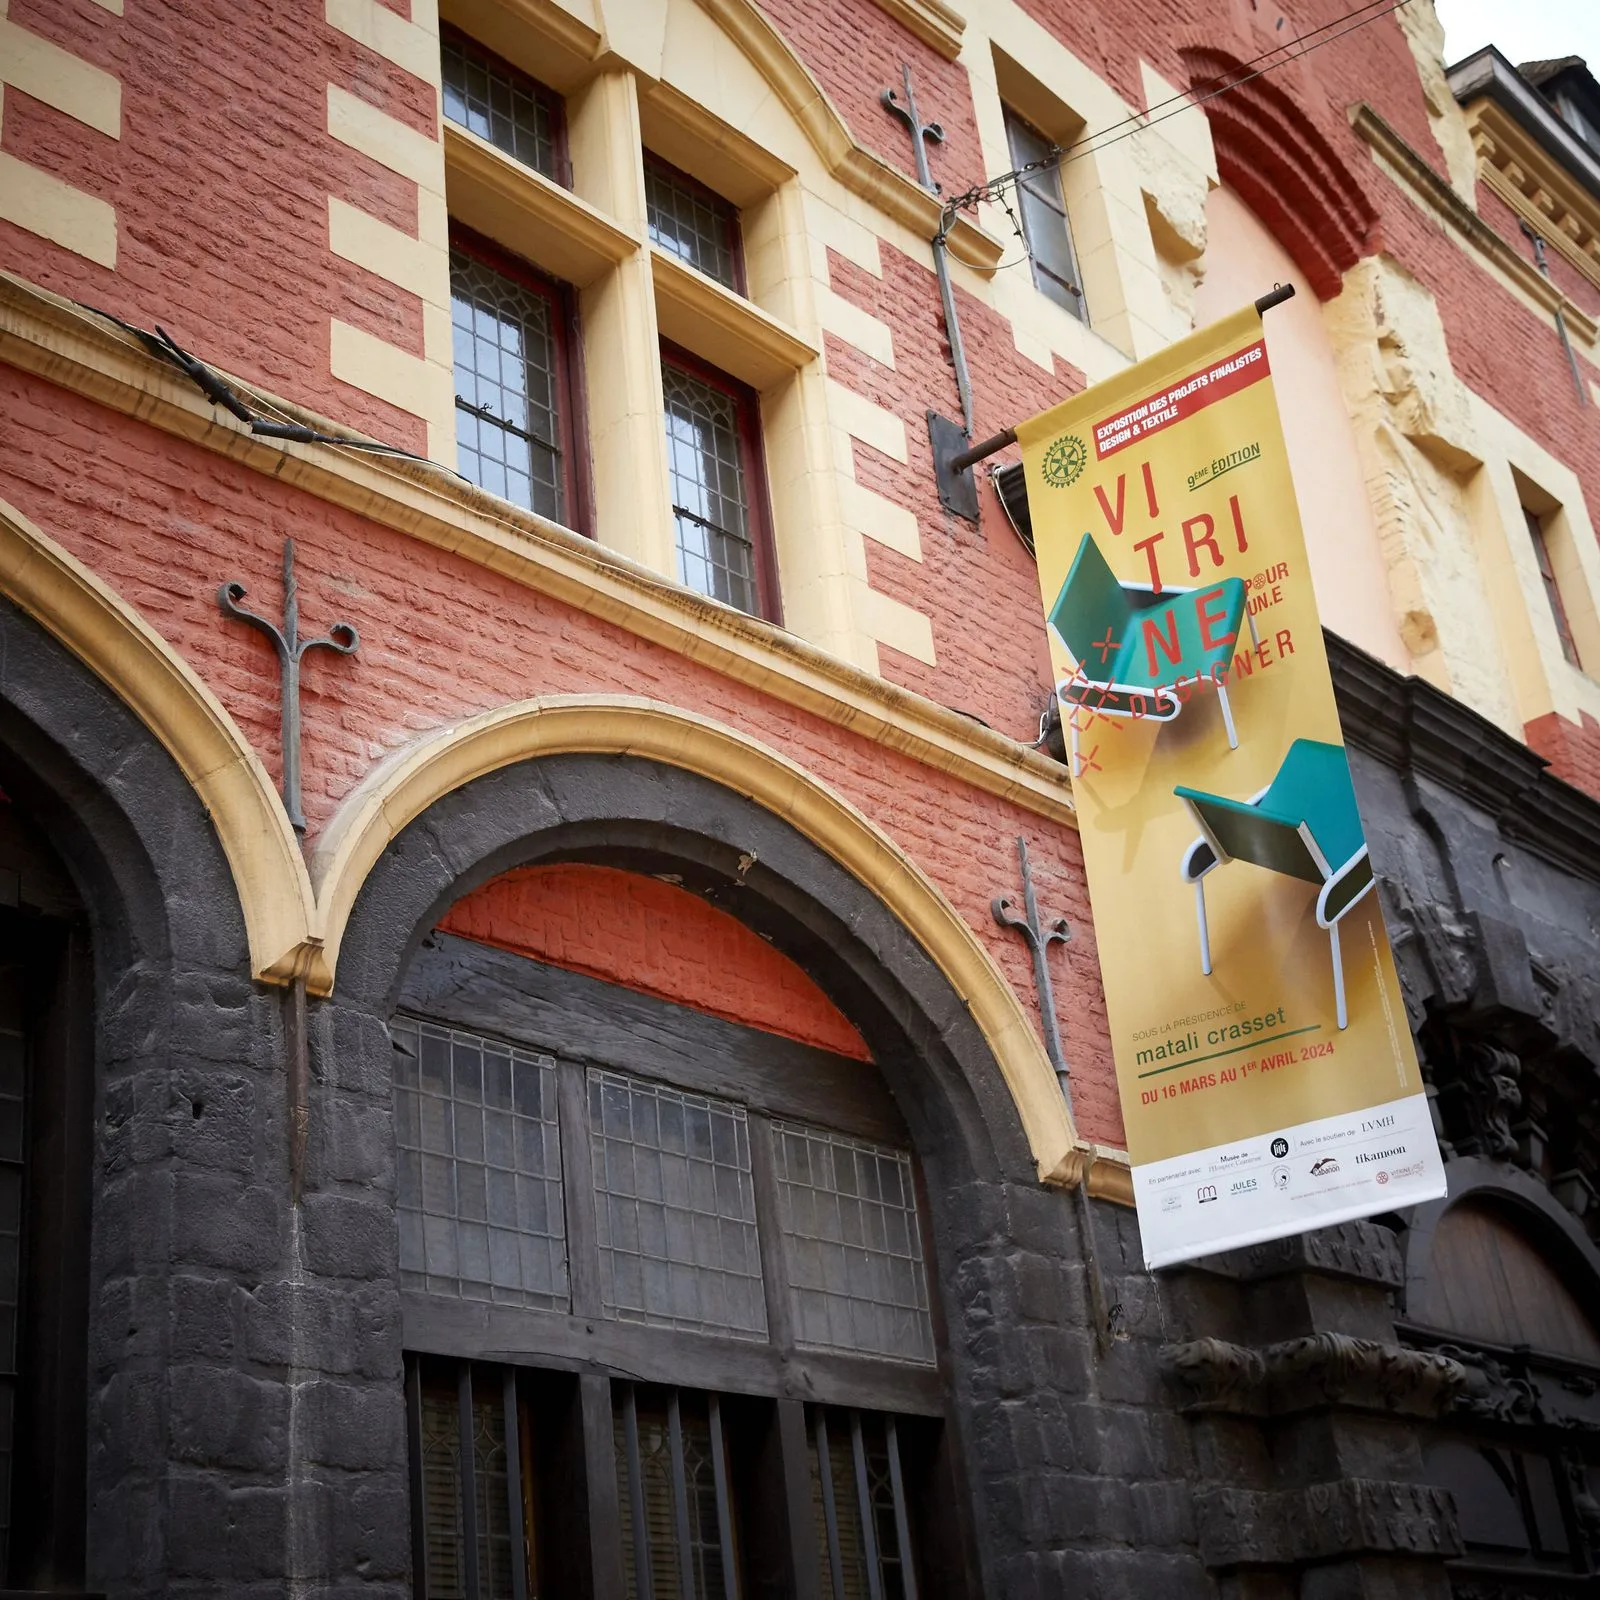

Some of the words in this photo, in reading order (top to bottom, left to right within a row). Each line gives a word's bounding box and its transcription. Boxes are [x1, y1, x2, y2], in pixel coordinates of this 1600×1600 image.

[1097, 405, 1148, 439] EXPOSITION
[1149, 396, 1168, 414] DES
[1168, 374, 1208, 404] PROJETS
[1209, 347, 1262, 382] FINALISTES
[1099, 428, 1132, 453] DESIGN
[1132, 424, 1141, 436] &
[1141, 405, 1178, 431] TEXTILE
[1211, 442, 1260, 475] ÉDITION
[1247, 585, 1283, 616] UN.E
[1129, 629, 1295, 721] DESIGNER
[1132, 1028, 1158, 1042] SOUS
[1160, 1023, 1171, 1034] LA
[1234, 1000, 1247, 1012] DE
[1136, 1032, 1199, 1066] matali
[1207, 1007, 1286, 1045] crasset
[1141, 1089, 1158, 1105] DU
[1161, 1084, 1177, 1100] 16
[1180, 1073, 1217, 1096] MARS
[1220, 1067, 1237, 1084] AU
[1260, 1051, 1298, 1073] AVRIL
[1301, 1041, 1334, 1061] 2024
[1300, 1138, 1314, 1147] Avec
[1322, 1132, 1346, 1142] soutien
[1347, 1129, 1356, 1137] de
[1361, 1115, 1395, 1133] LVMH
[1355, 1144, 1406, 1164] tikamoon
[1148, 1177, 1156, 1185] En
[1157, 1169, 1187, 1184] partenariat
[1188, 1167, 1201, 1176] avec
[1231, 1178, 1257, 1192] JULES
